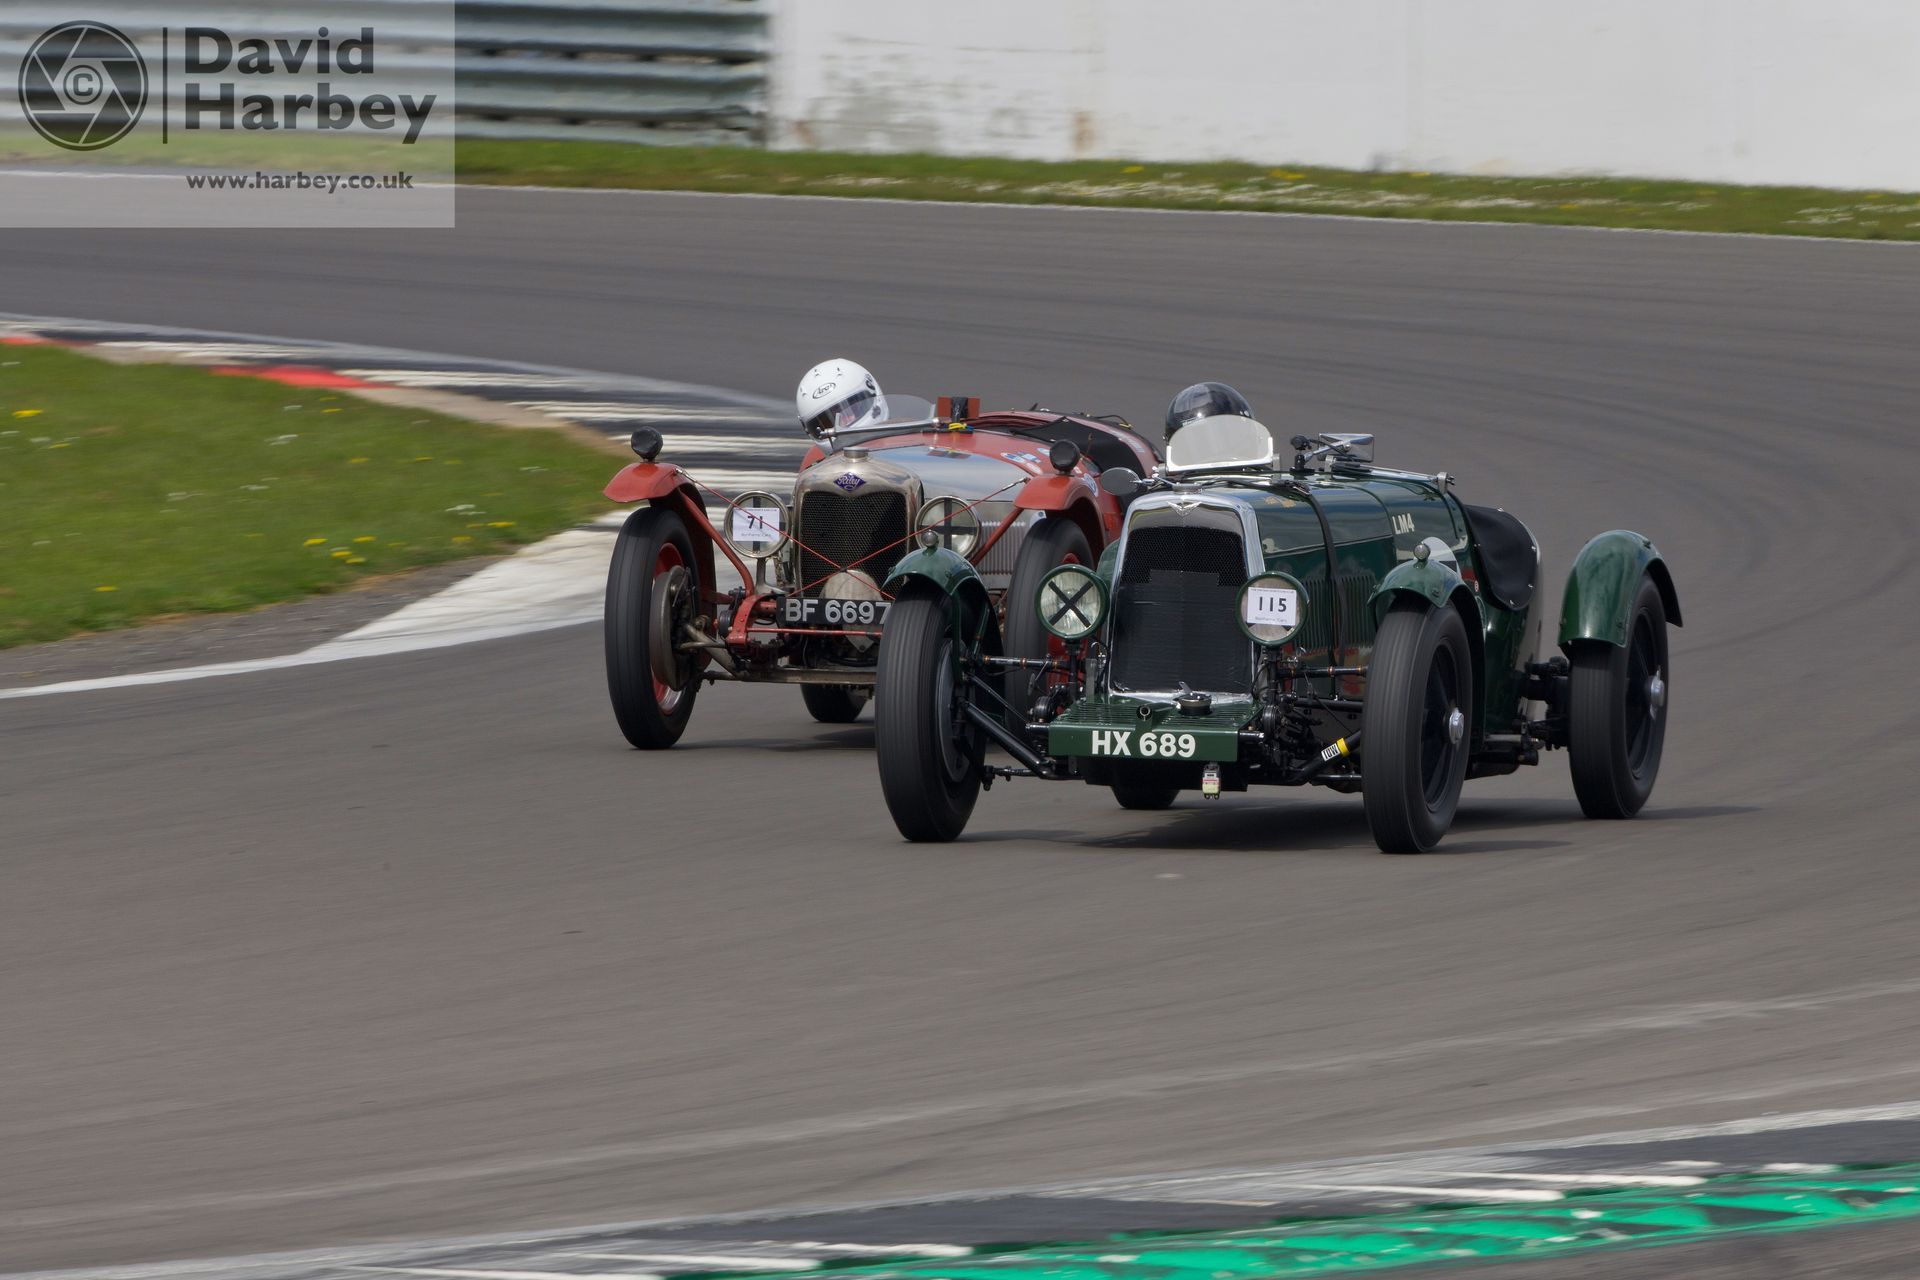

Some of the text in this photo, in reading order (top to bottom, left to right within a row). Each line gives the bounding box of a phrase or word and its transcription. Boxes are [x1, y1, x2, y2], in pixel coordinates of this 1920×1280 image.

[837, 475, 860, 489] Riley
[748, 515, 763, 529] 71
[1392, 513, 1415, 534] LM4
[785, 599, 891, 624] BF 6697
[1259, 596, 1287, 612] 115
[1092, 730, 1196, 758] HX 689
